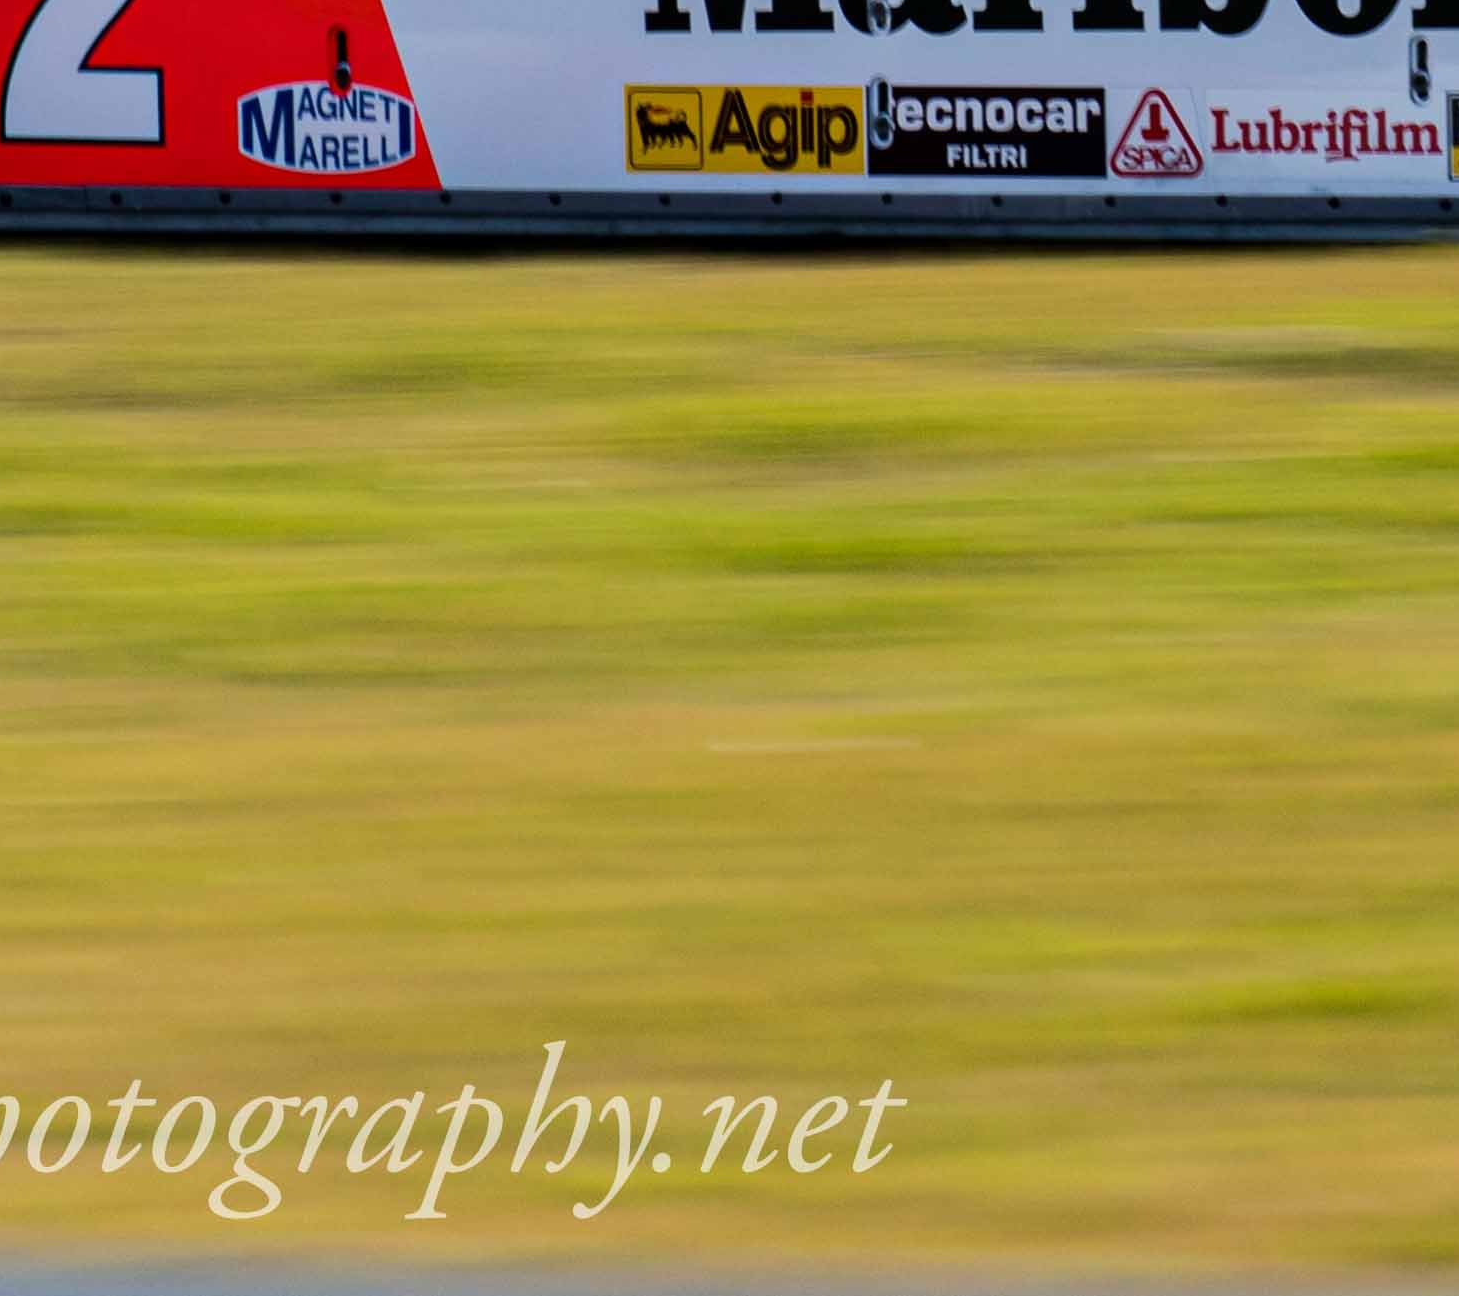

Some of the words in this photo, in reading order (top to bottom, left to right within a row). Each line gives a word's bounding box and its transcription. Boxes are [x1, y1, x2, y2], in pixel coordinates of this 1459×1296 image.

[710, 89, 859, 170] Agip
[888, 95, 1102, 134] ecnocar
[1210, 106, 1443, 163] Lubrifilm
[946, 143, 1028, 169] FILTRI
